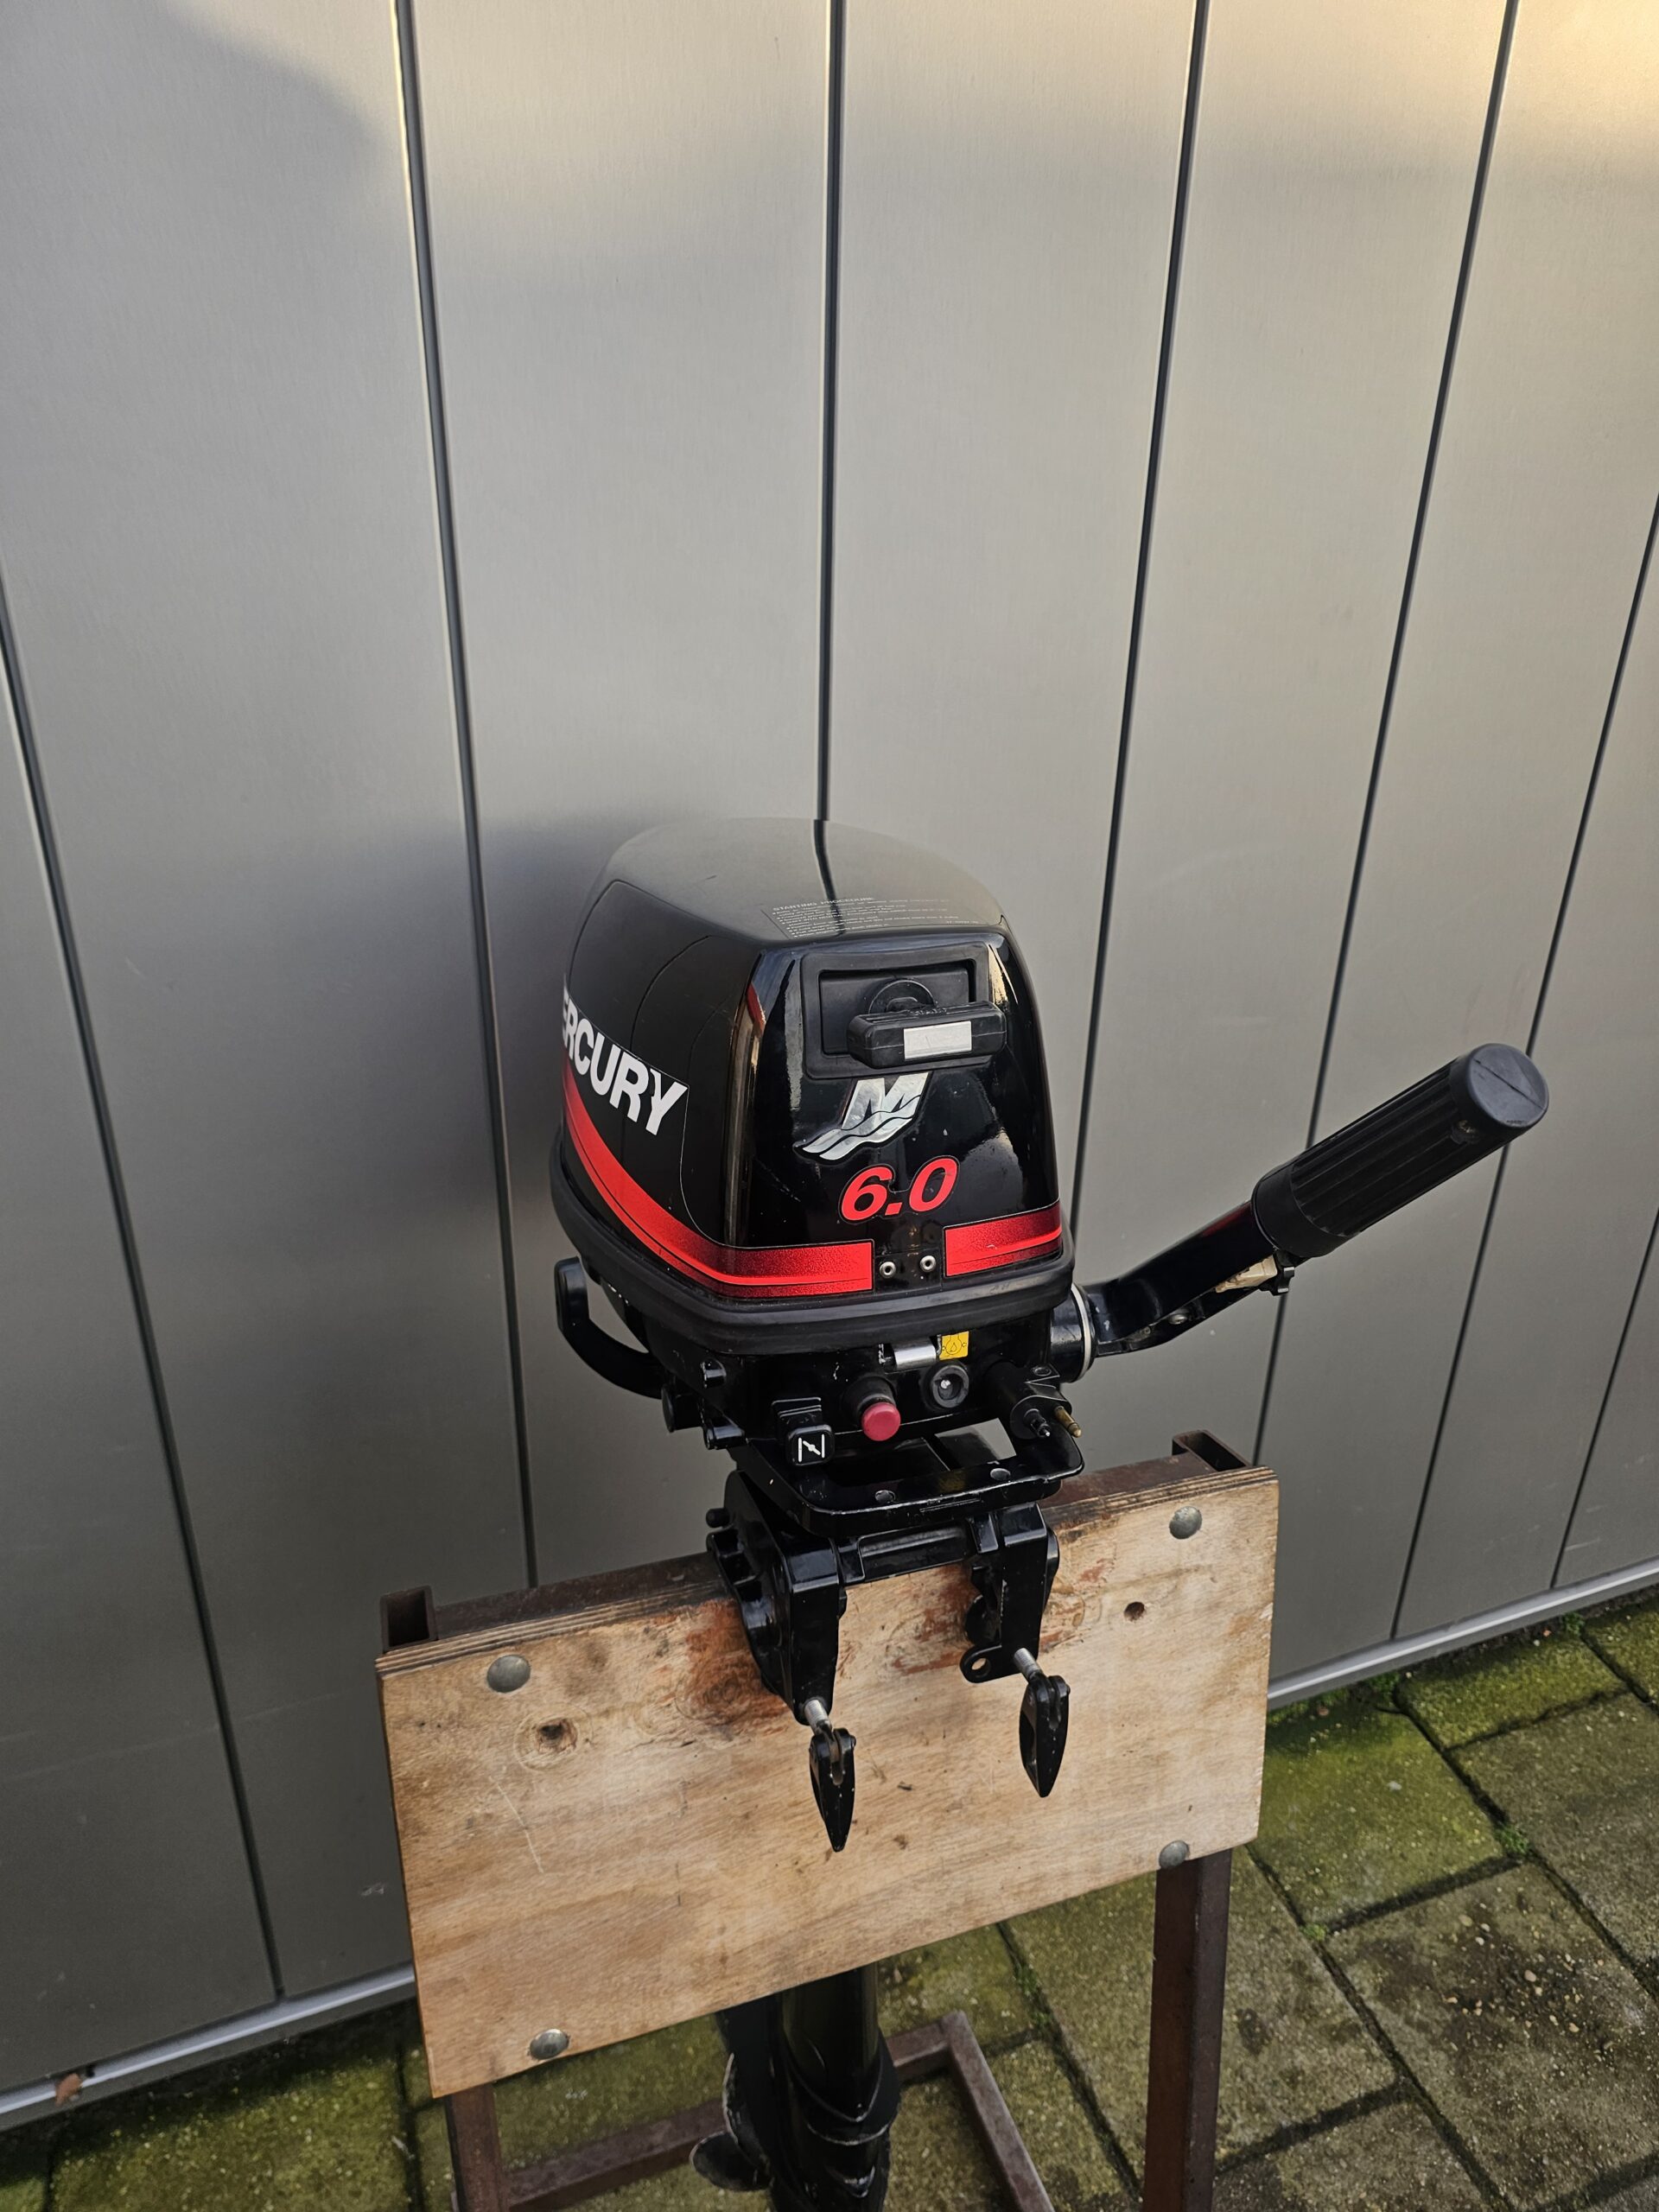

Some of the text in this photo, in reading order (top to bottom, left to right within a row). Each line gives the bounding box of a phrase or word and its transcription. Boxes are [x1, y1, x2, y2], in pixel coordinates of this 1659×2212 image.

[772, 901, 817, 912] STARTING
[562, 983, 689, 1136] ERCURY
[841, 1157, 958, 1222] 6.0
